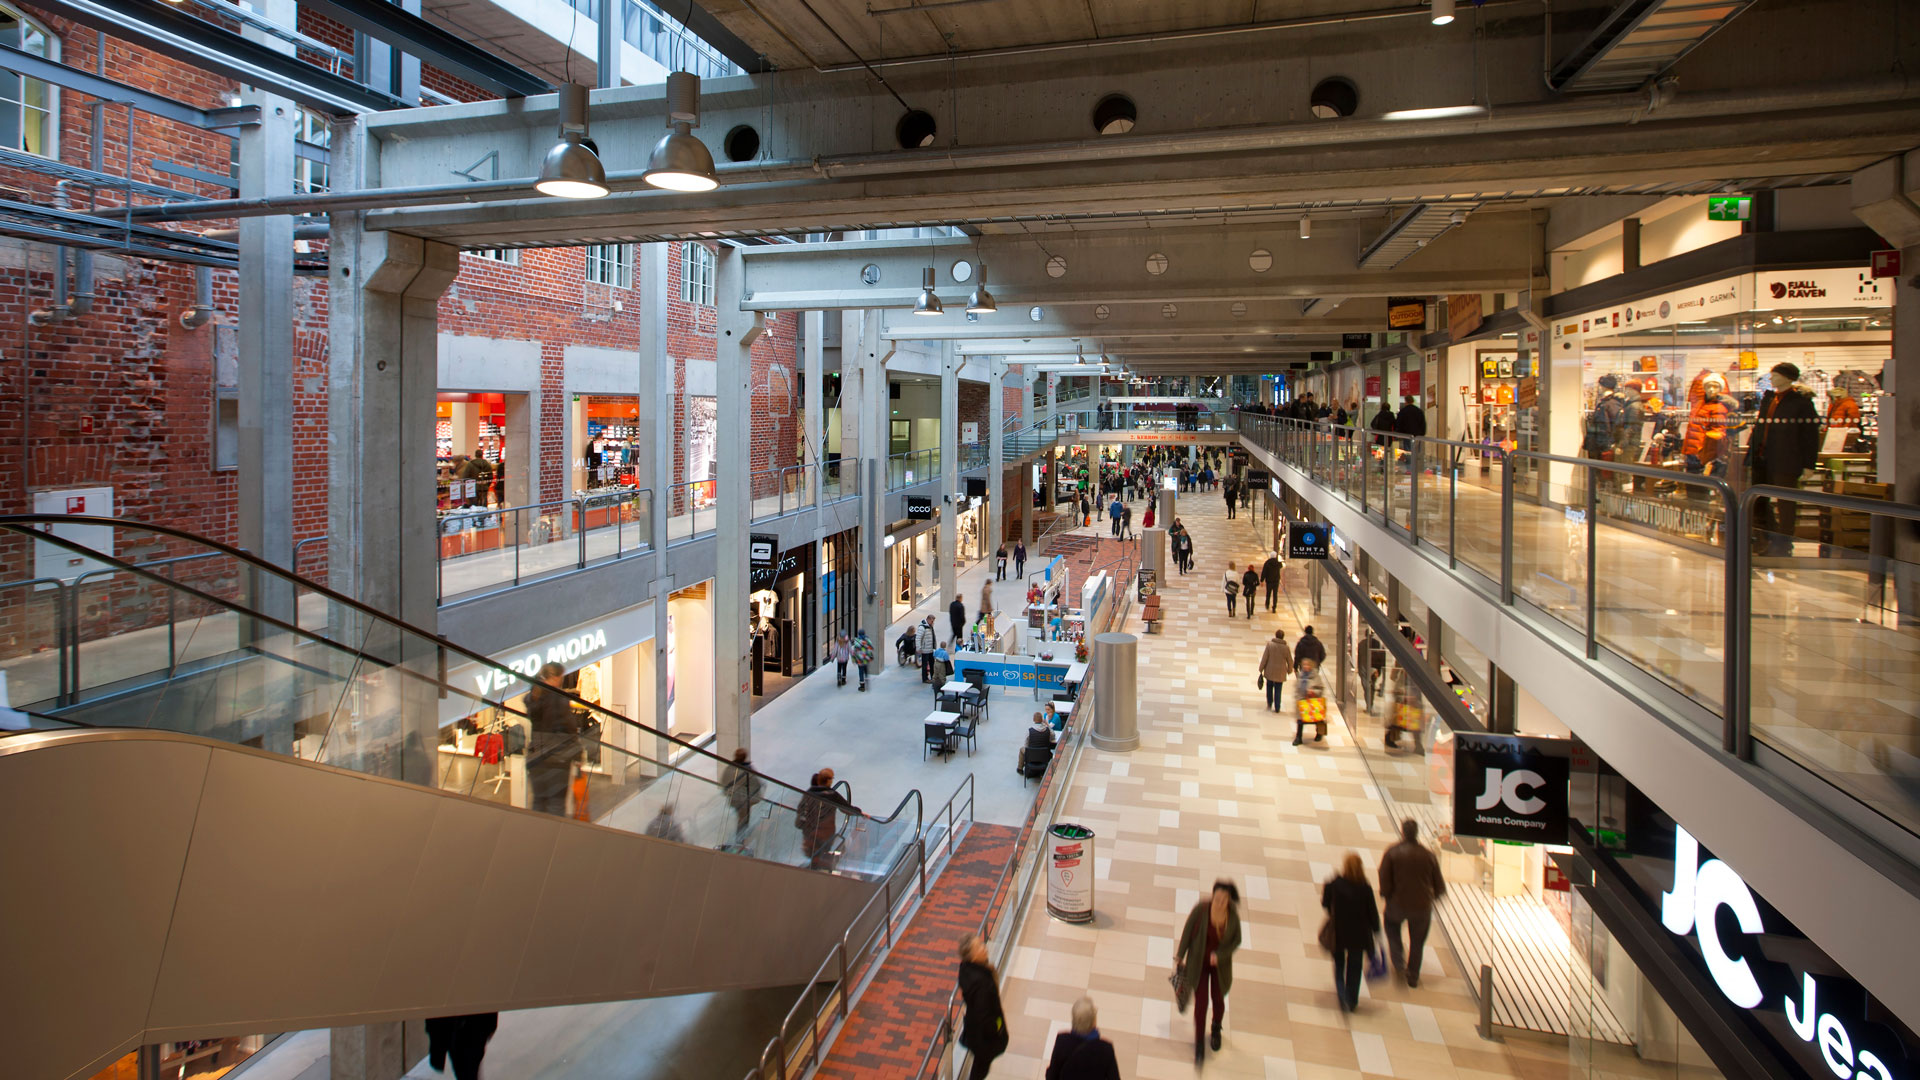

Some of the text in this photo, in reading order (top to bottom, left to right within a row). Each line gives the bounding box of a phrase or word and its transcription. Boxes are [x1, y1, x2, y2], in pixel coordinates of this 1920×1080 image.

[1677, 301, 1700, 310] MERRELL
[1710, 292, 1736, 304] GARMIN
[908, 505, 931, 513] ecco
[475, 628, 607, 696] VERO MODA
[1476, 767, 1547, 815] JC
[1475, 814, 1547, 830] Jeans Company
[1661, 823, 1765, 1009] JC
